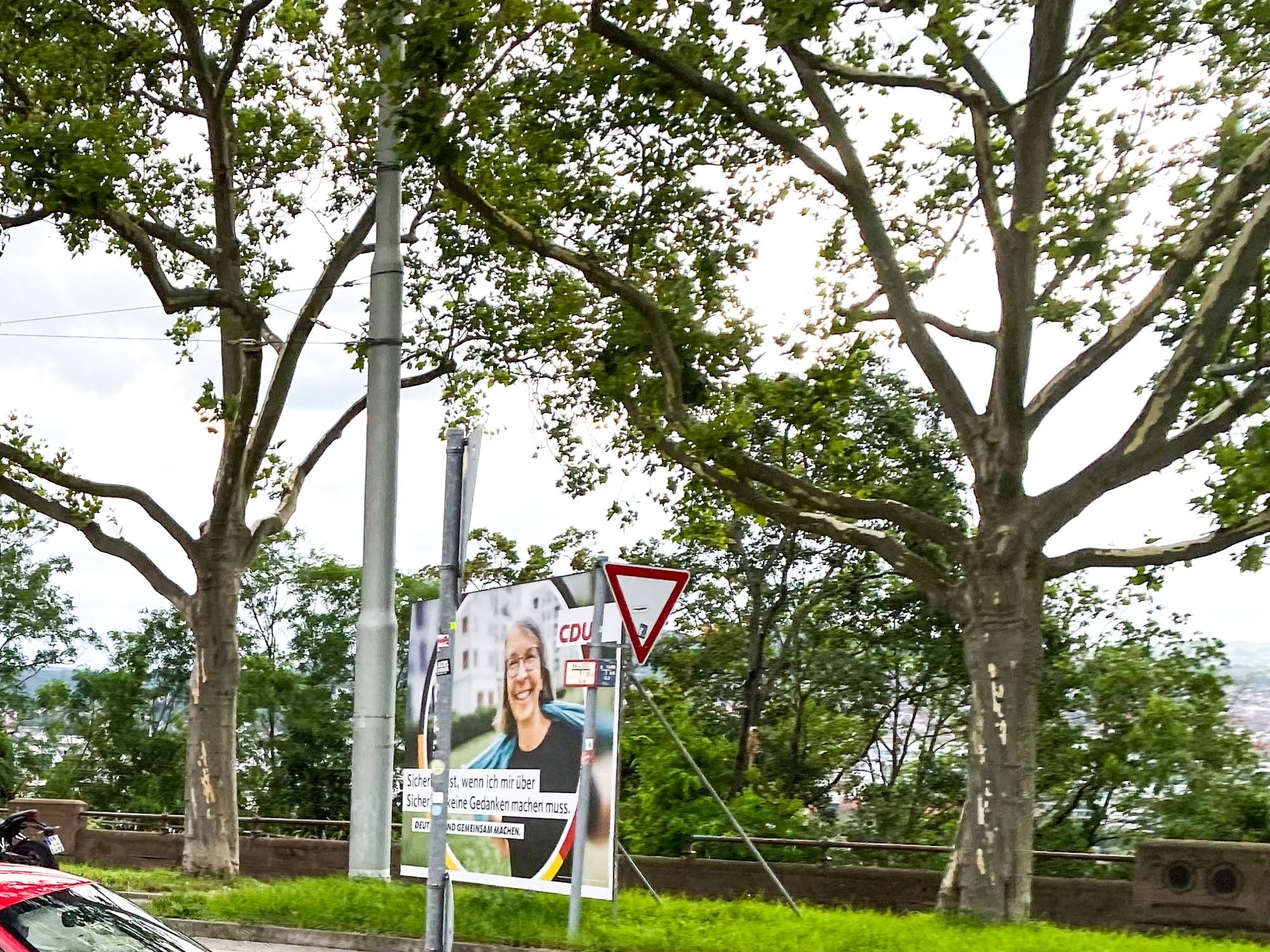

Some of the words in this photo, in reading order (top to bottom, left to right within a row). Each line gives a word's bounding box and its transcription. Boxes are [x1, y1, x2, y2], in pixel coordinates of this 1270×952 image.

[559, 621, 594, 643] CDU
[449, 775, 460, 790] st,
[461, 777, 484, 788] wenn
[486, 774, 499, 789] ich
[501, 774, 514, 789] mir
[516, 774, 535, 790] über
[470, 795, 510, 811] Gedanken
[511, 797, 544, 813] machen
[546, 802, 571, 814] muss.
[457, 823, 493, 834] GEMEINSAM
[494, 825, 521, 836] MACHEN.
